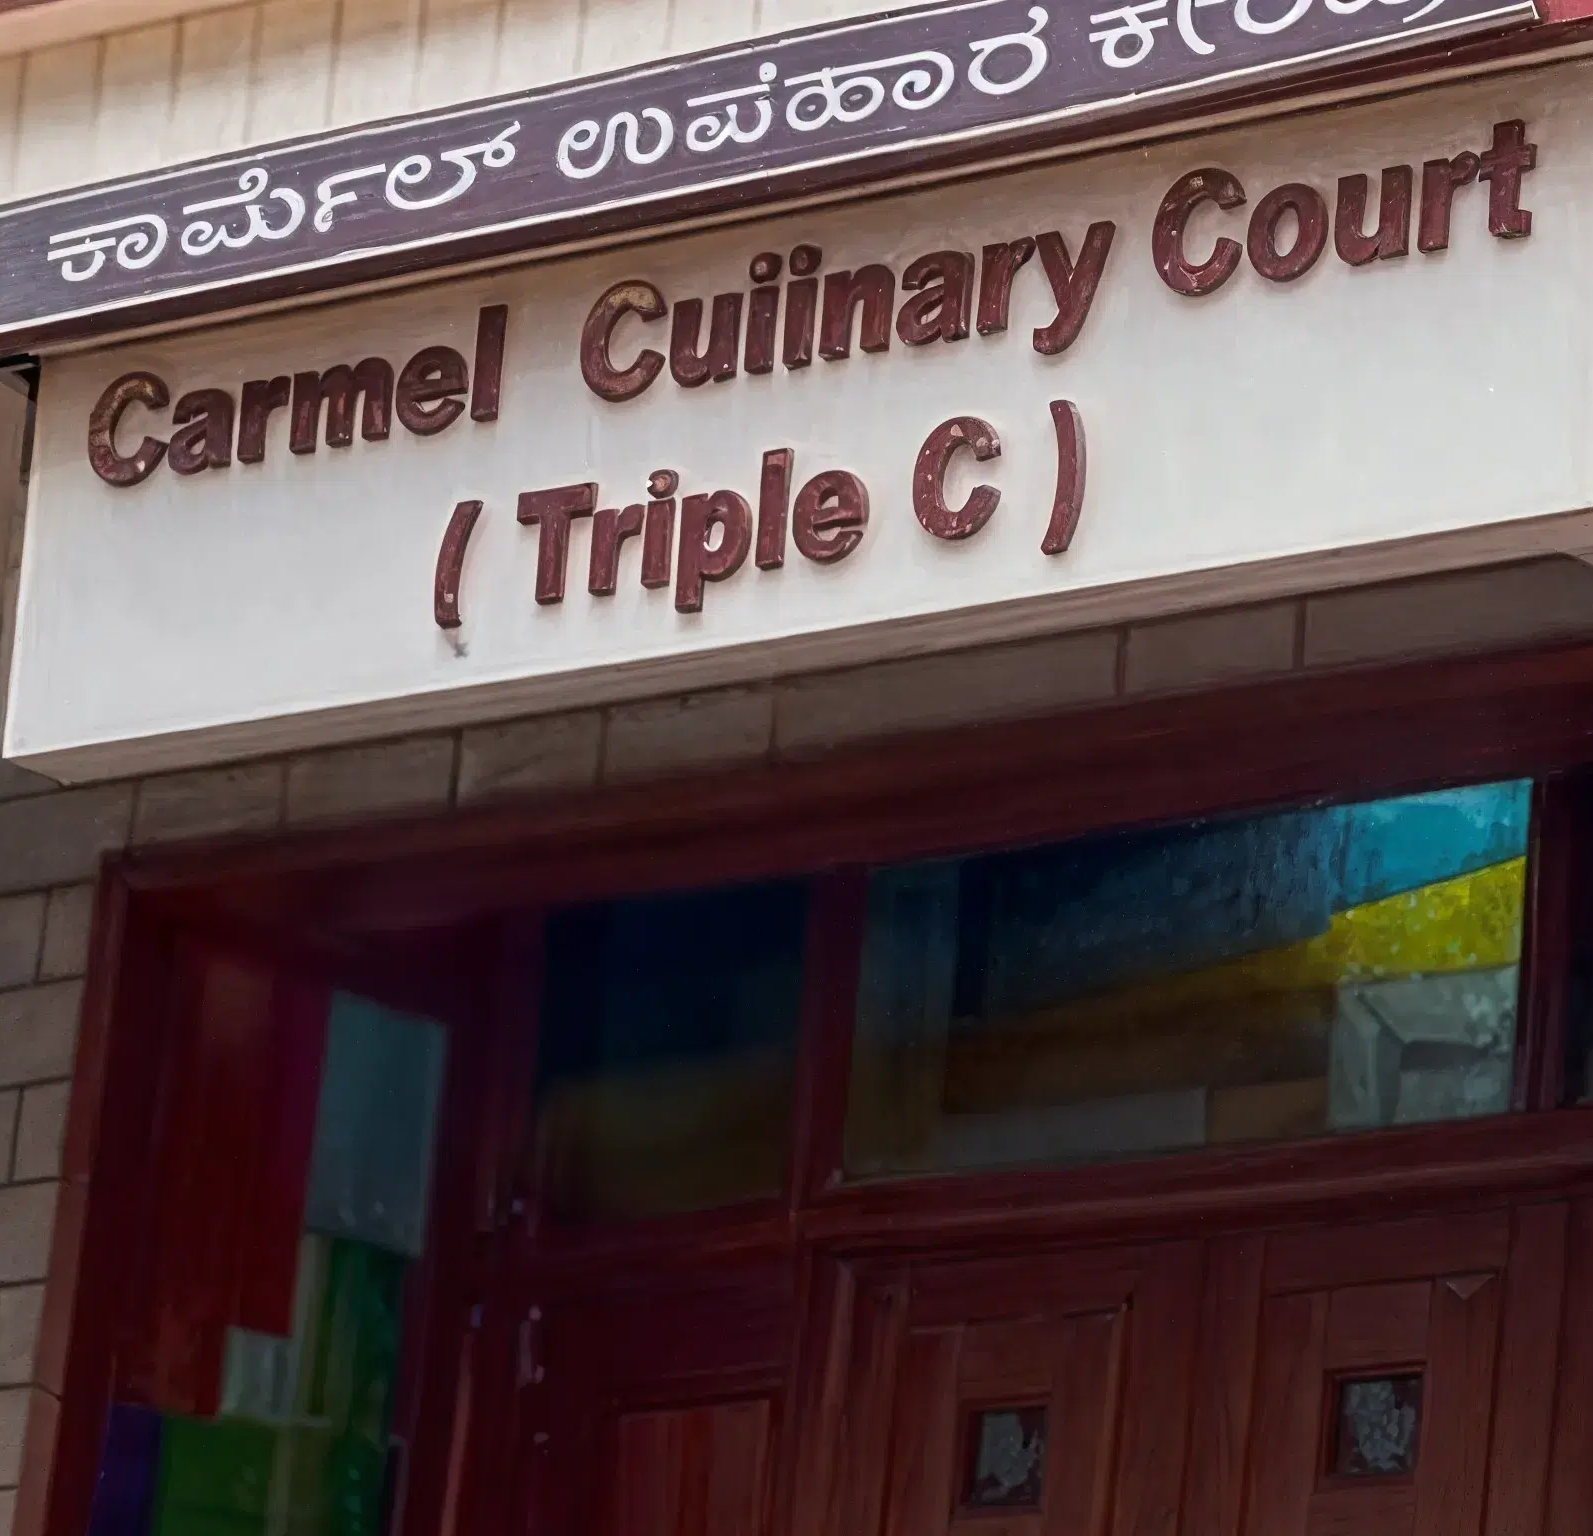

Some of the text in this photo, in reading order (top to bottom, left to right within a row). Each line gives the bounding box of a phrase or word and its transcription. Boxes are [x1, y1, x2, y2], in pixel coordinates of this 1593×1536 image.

[86, 118, 1538, 488] Carmel Cuiinary Court
